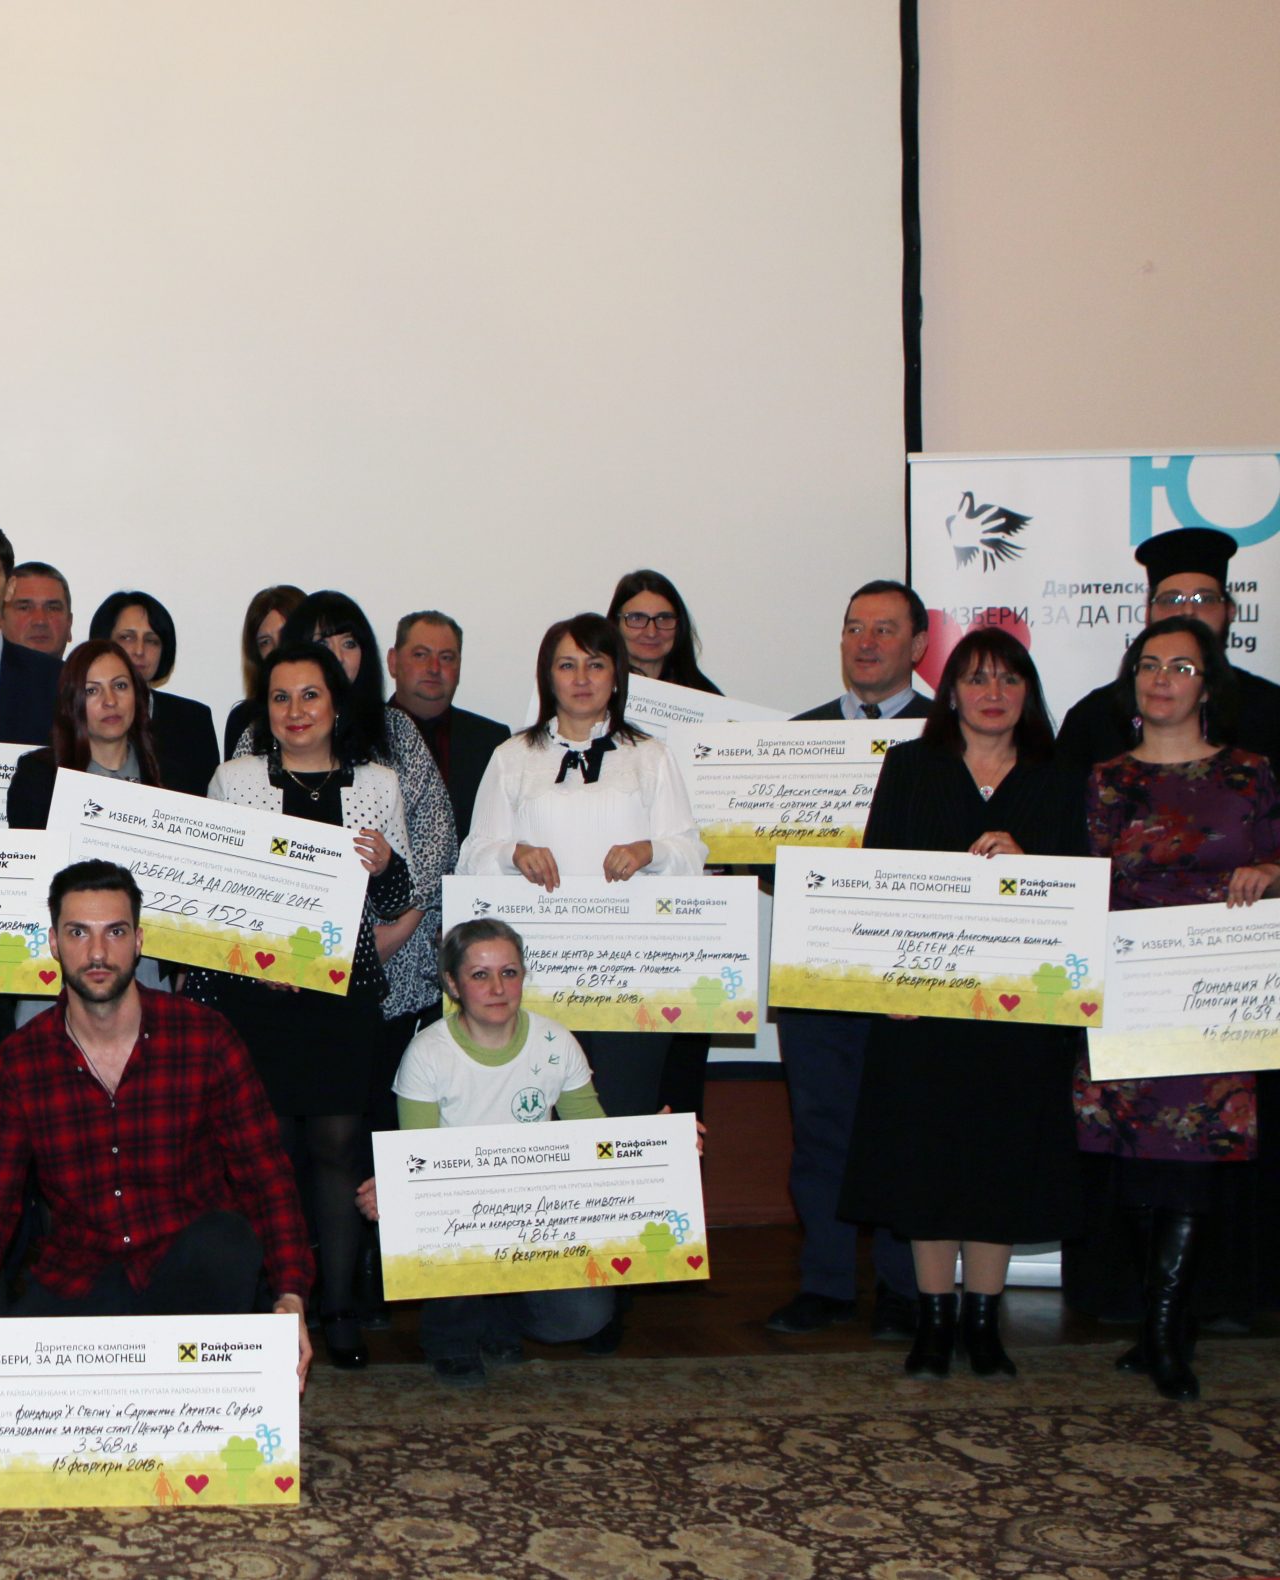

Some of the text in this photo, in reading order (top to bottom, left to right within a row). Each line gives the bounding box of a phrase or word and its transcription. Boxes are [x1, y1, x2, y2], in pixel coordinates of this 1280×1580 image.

[1041, 607, 1070, 625] ЗА
[1077, 606, 1109, 627] ДА
[756, 738, 805, 748] Дарителска
[757, 748, 769, 756] ЗА
[772, 748, 786, 757] ДА
[789, 747, 845, 756] ПОМОГНЕШ
[152, 808, 246, 836] Дарителска кампания
[794, 810, 820, 823] 251
[108, 811, 244, 847] ИЗБЕРИ, ЗА ДА ПОМОГНЕШ
[290, 840, 342, 858] Райфайзен
[289, 850, 316, 862] БАНК
[874, 869, 927, 881] Дарителска
[832, 878, 971, 894] ИЗБЕРИ, ЗА ДА ПОМОГНЕШ
[1020, 878, 1076, 889] Райфайзен
[1020, 888, 1048, 897] БАНК
[537, 894, 588, 906] Дарителска
[675, 898, 727, 908] Райфайзен
[142, 888, 249, 929] 226 152
[539, 905, 551, 914] ЗА
[554, 905, 568, 915] ДА
[572, 905, 630, 914] ПОМОГНЕШ
[675, 907, 702, 915] БАНК
[951, 943, 975, 957] ДЕН
[615, 1139, 667, 1149] Райфайзен
[474, 1144, 570, 1157] Дарителска кампания
[616, 1149, 643, 1158] БАНК
[433, 1152, 570, 1169] ИЗБЕРИ, ЗА ДА ПОМОГНЕШ
[528, 1227, 559, 1244] 867
[34, 1342, 95, 1354] Дарителска
[201, 1342, 262, 1353] Райфайзен
[36, 1354, 51, 1364] ЗА
[56, 1354, 72, 1366] ДА
[76, 1353, 146, 1364] ПОМОГНЕШ
[201, 1353, 232, 1362] БАНК
[90, 1437, 123, 1453] 368
